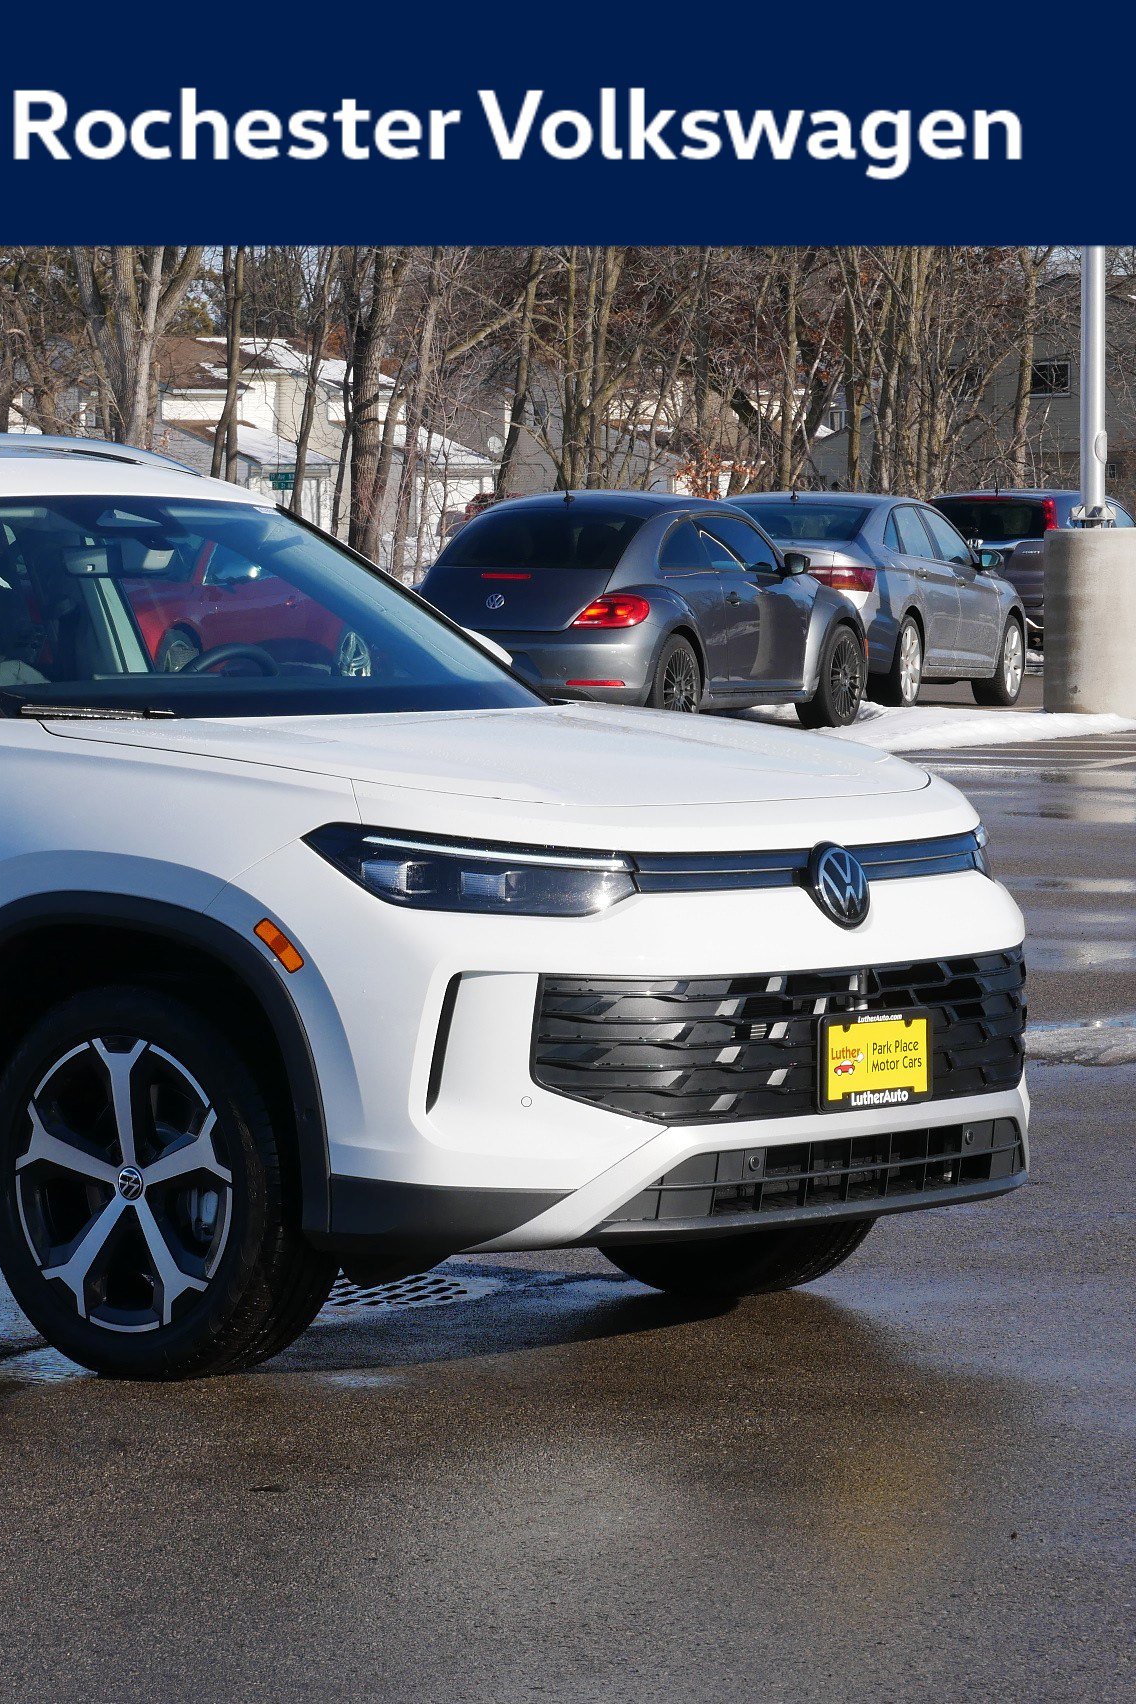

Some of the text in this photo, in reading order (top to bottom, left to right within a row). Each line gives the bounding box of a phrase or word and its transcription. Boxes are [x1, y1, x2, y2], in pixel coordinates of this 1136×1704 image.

[857, 1014, 903, 1023] LutherAuto.com
[831, 1047, 861, 1060] Luther
[872, 1039, 919, 1056] Park Place
[871, 1056, 922, 1073] Motor Cars
[851, 1089, 909, 1107] LutherAuto
